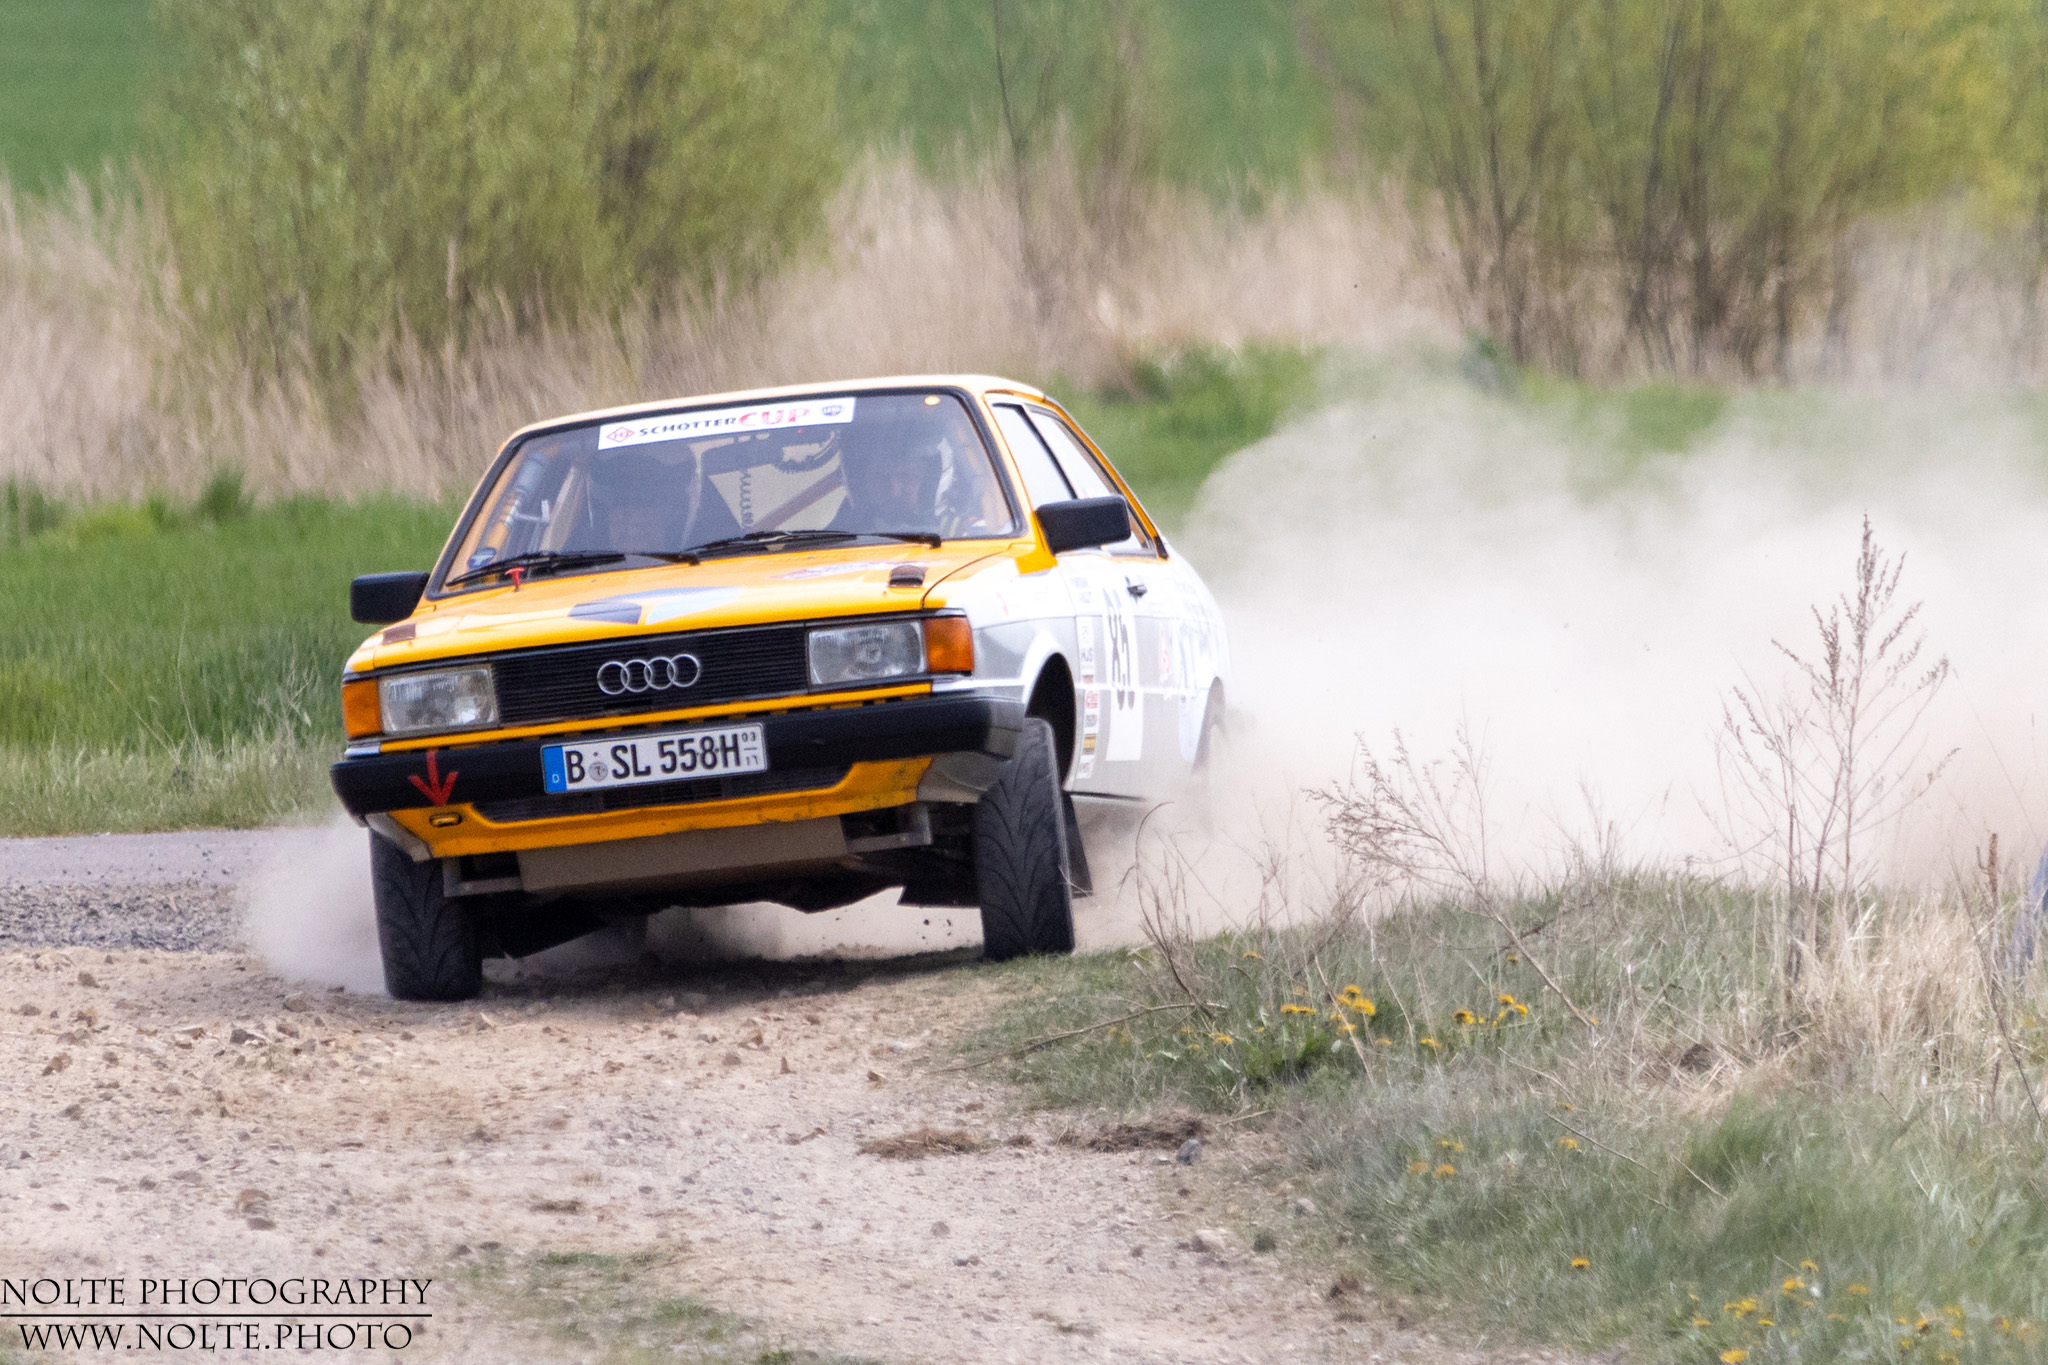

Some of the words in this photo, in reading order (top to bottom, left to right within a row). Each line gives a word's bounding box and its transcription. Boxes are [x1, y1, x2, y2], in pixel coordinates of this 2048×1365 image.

[741, 731, 756, 742] 03
[565, 750, 586, 784] B
[610, 743, 651, 779] SL
[657, 732, 741, 775] 558H
[552, 774, 560, 784] D
